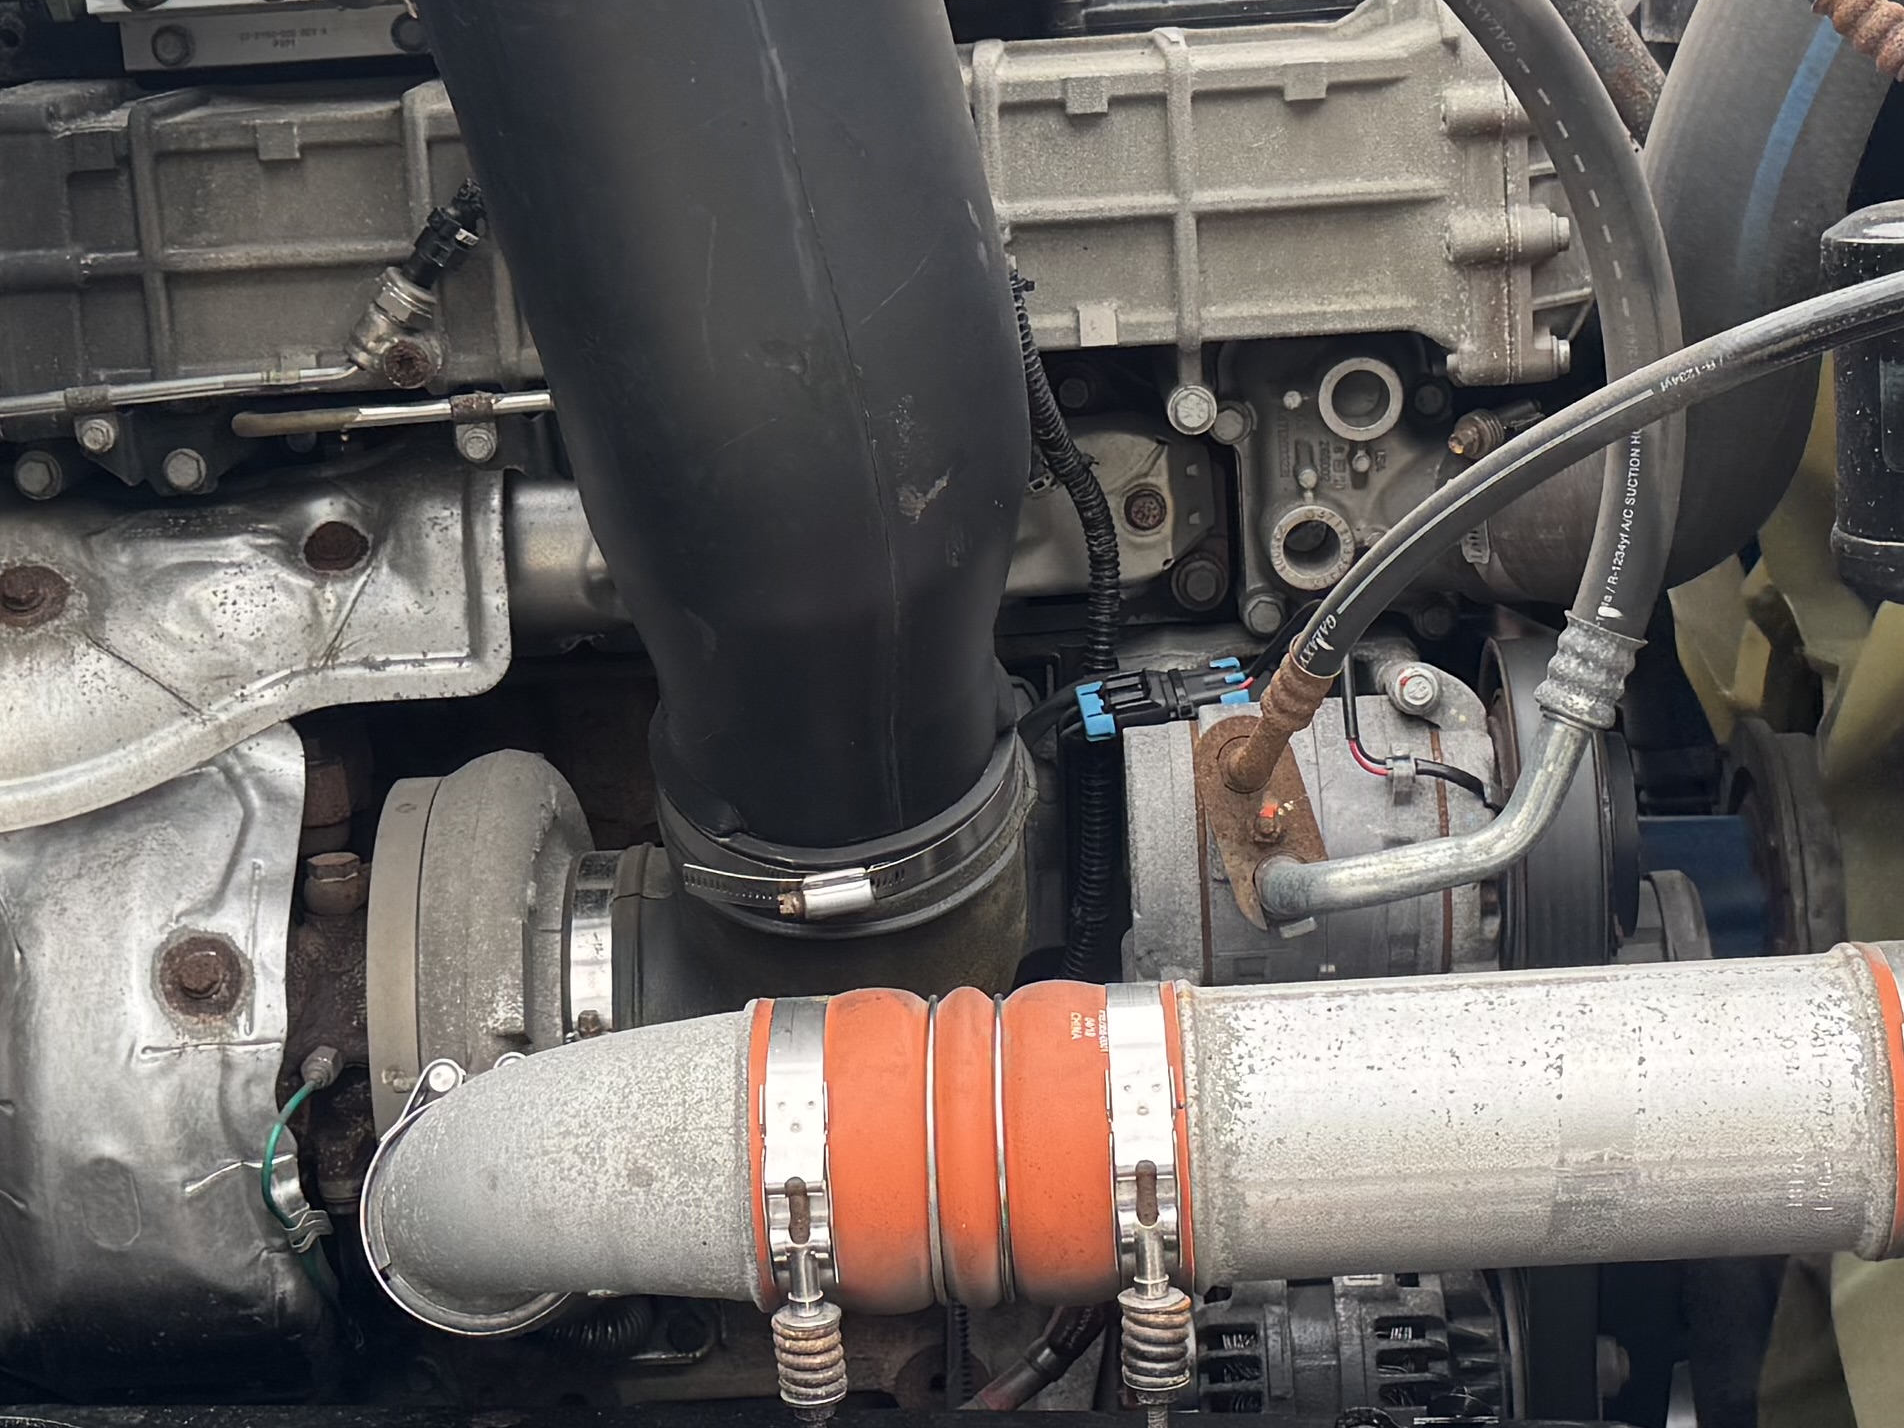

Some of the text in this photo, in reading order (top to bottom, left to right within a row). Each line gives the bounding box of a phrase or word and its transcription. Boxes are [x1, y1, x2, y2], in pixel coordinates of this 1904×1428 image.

[1625, 448, 1641, 505] SUCTION
[1621, 509, 1634, 532] A/C
[1607, 533, 1630, 585] R-1234yf
[1071, 1012, 1083, 1040] CHINA
